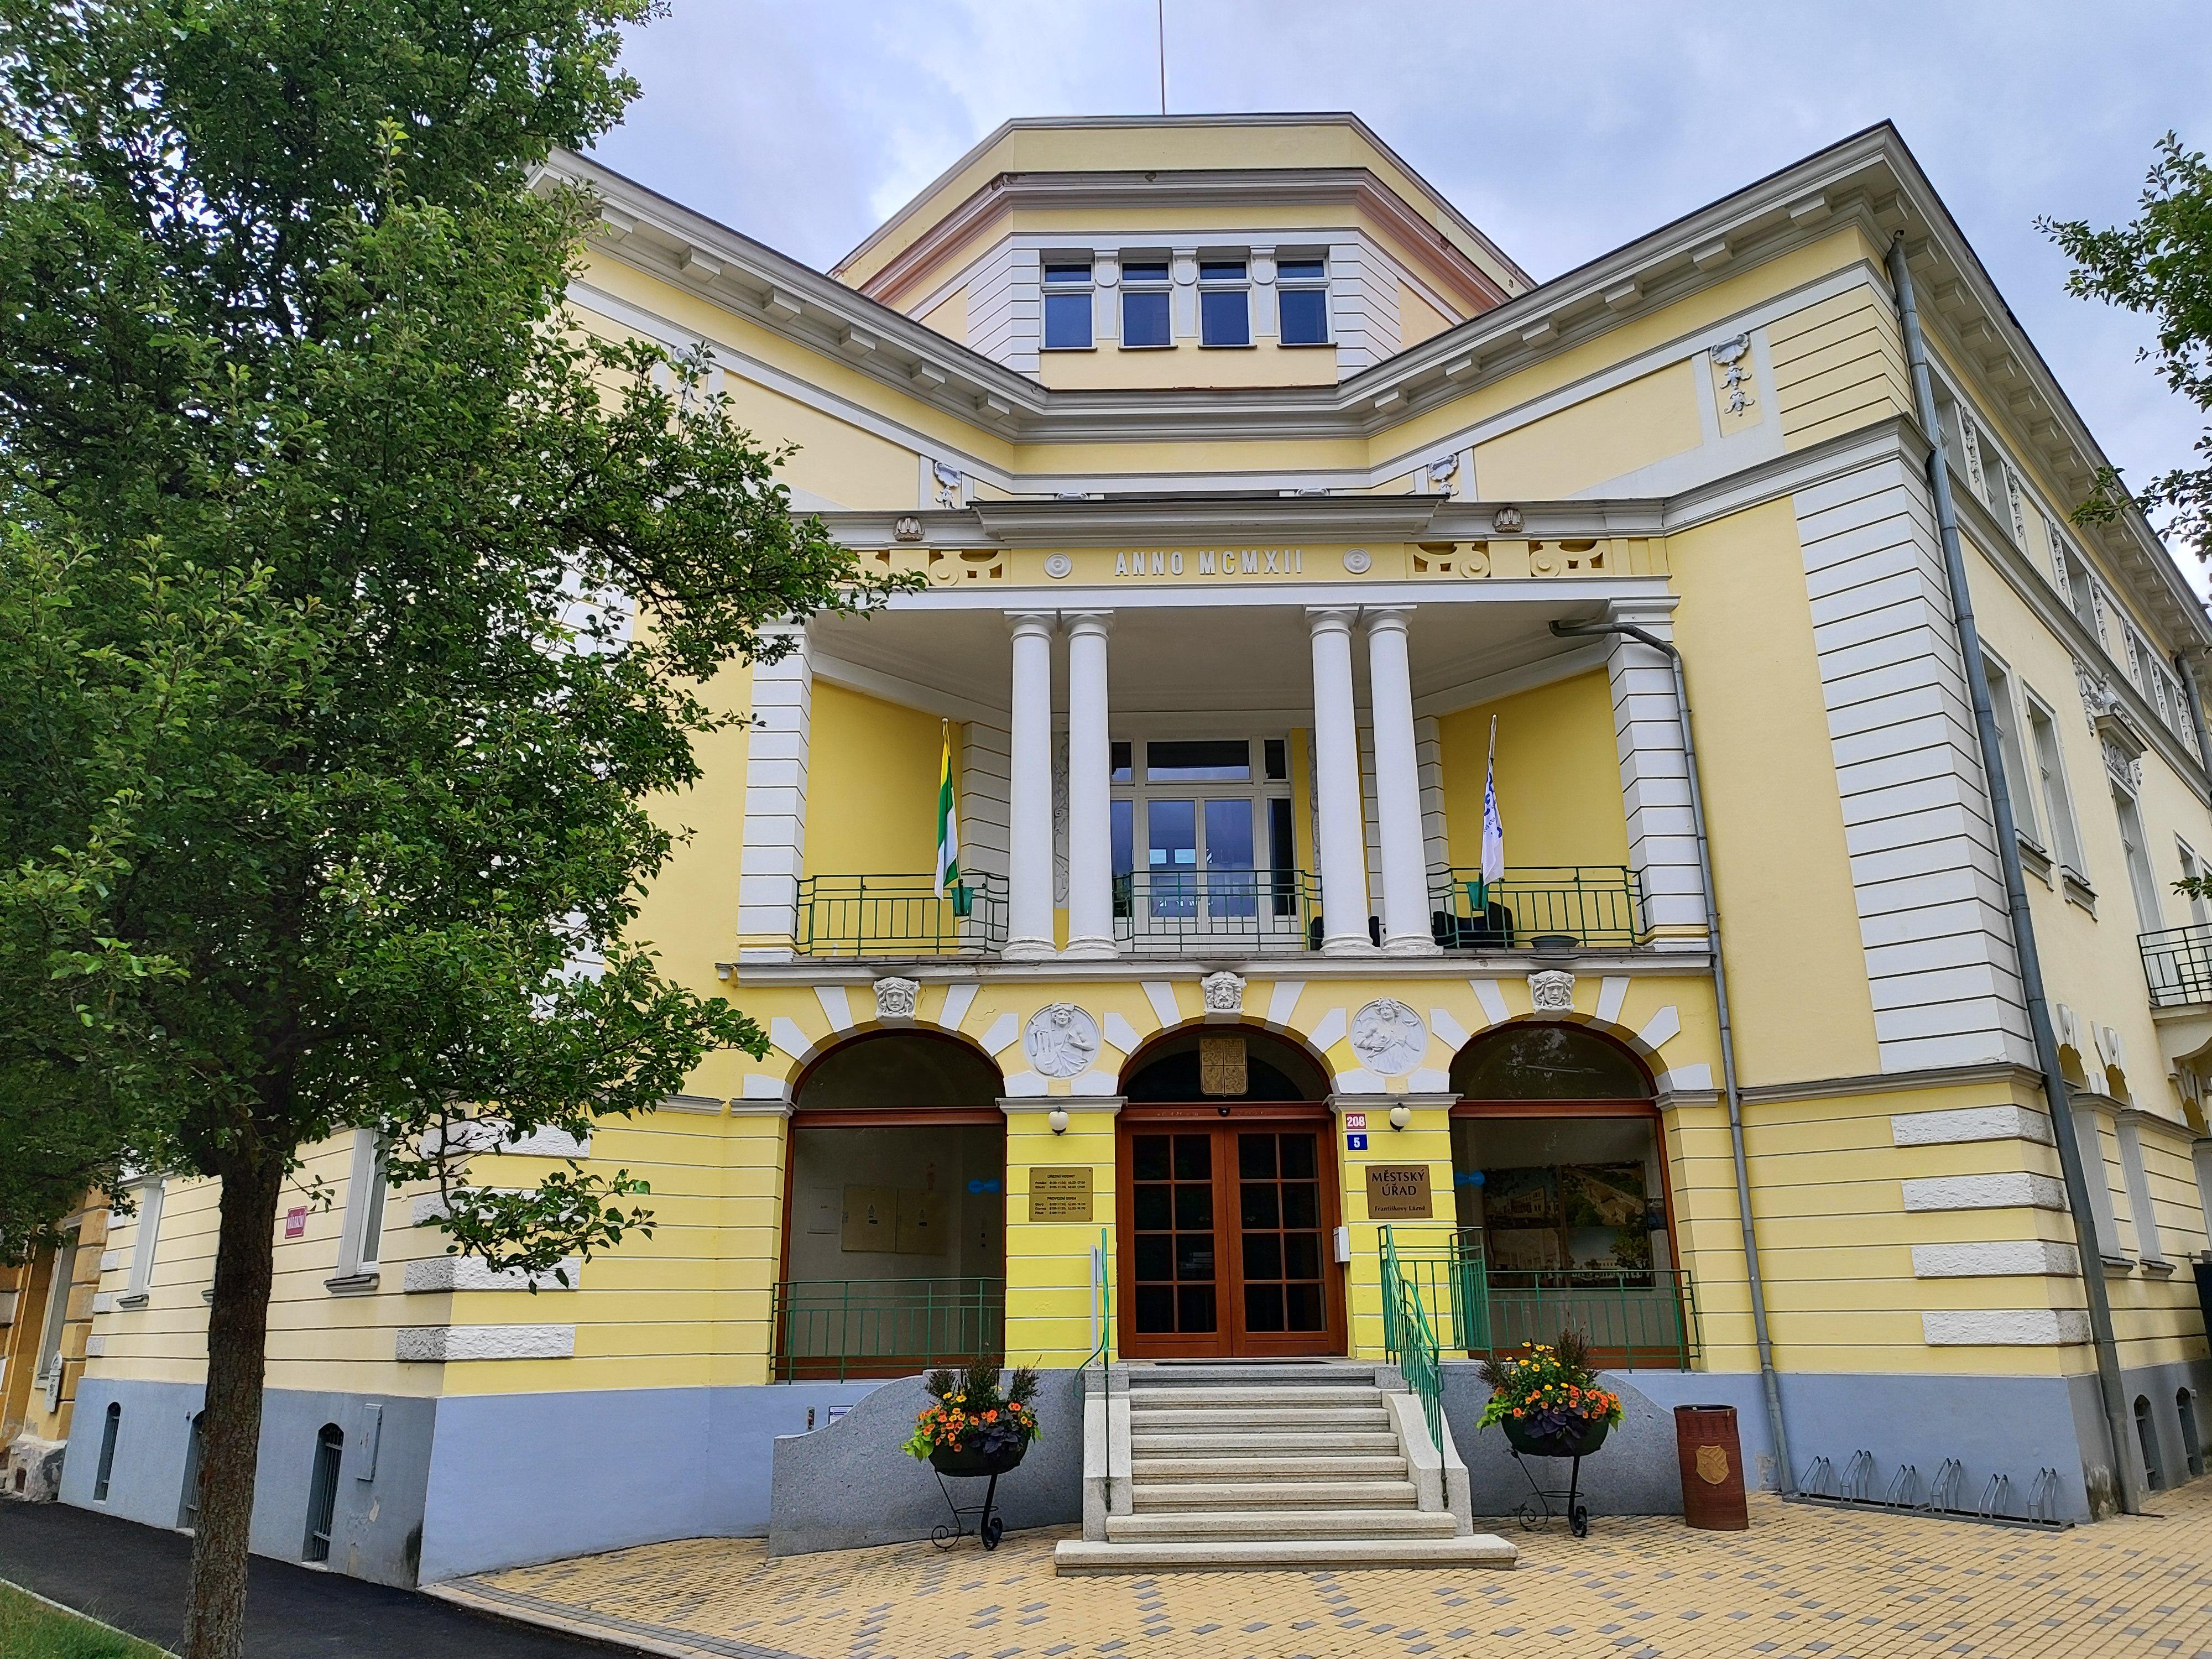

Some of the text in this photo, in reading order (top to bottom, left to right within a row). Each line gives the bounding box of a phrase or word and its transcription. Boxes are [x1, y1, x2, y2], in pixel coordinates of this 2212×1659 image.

[1115, 549, 1302, 576] ANNO MCMXII
[1347, 1116, 1365, 1127] 208
[1354, 1137, 1360, 1148] 5
[1371, 1168, 1425, 1182] MĚSTSKÝ
[1381, 1183, 1417, 1196] ÚŘAD
